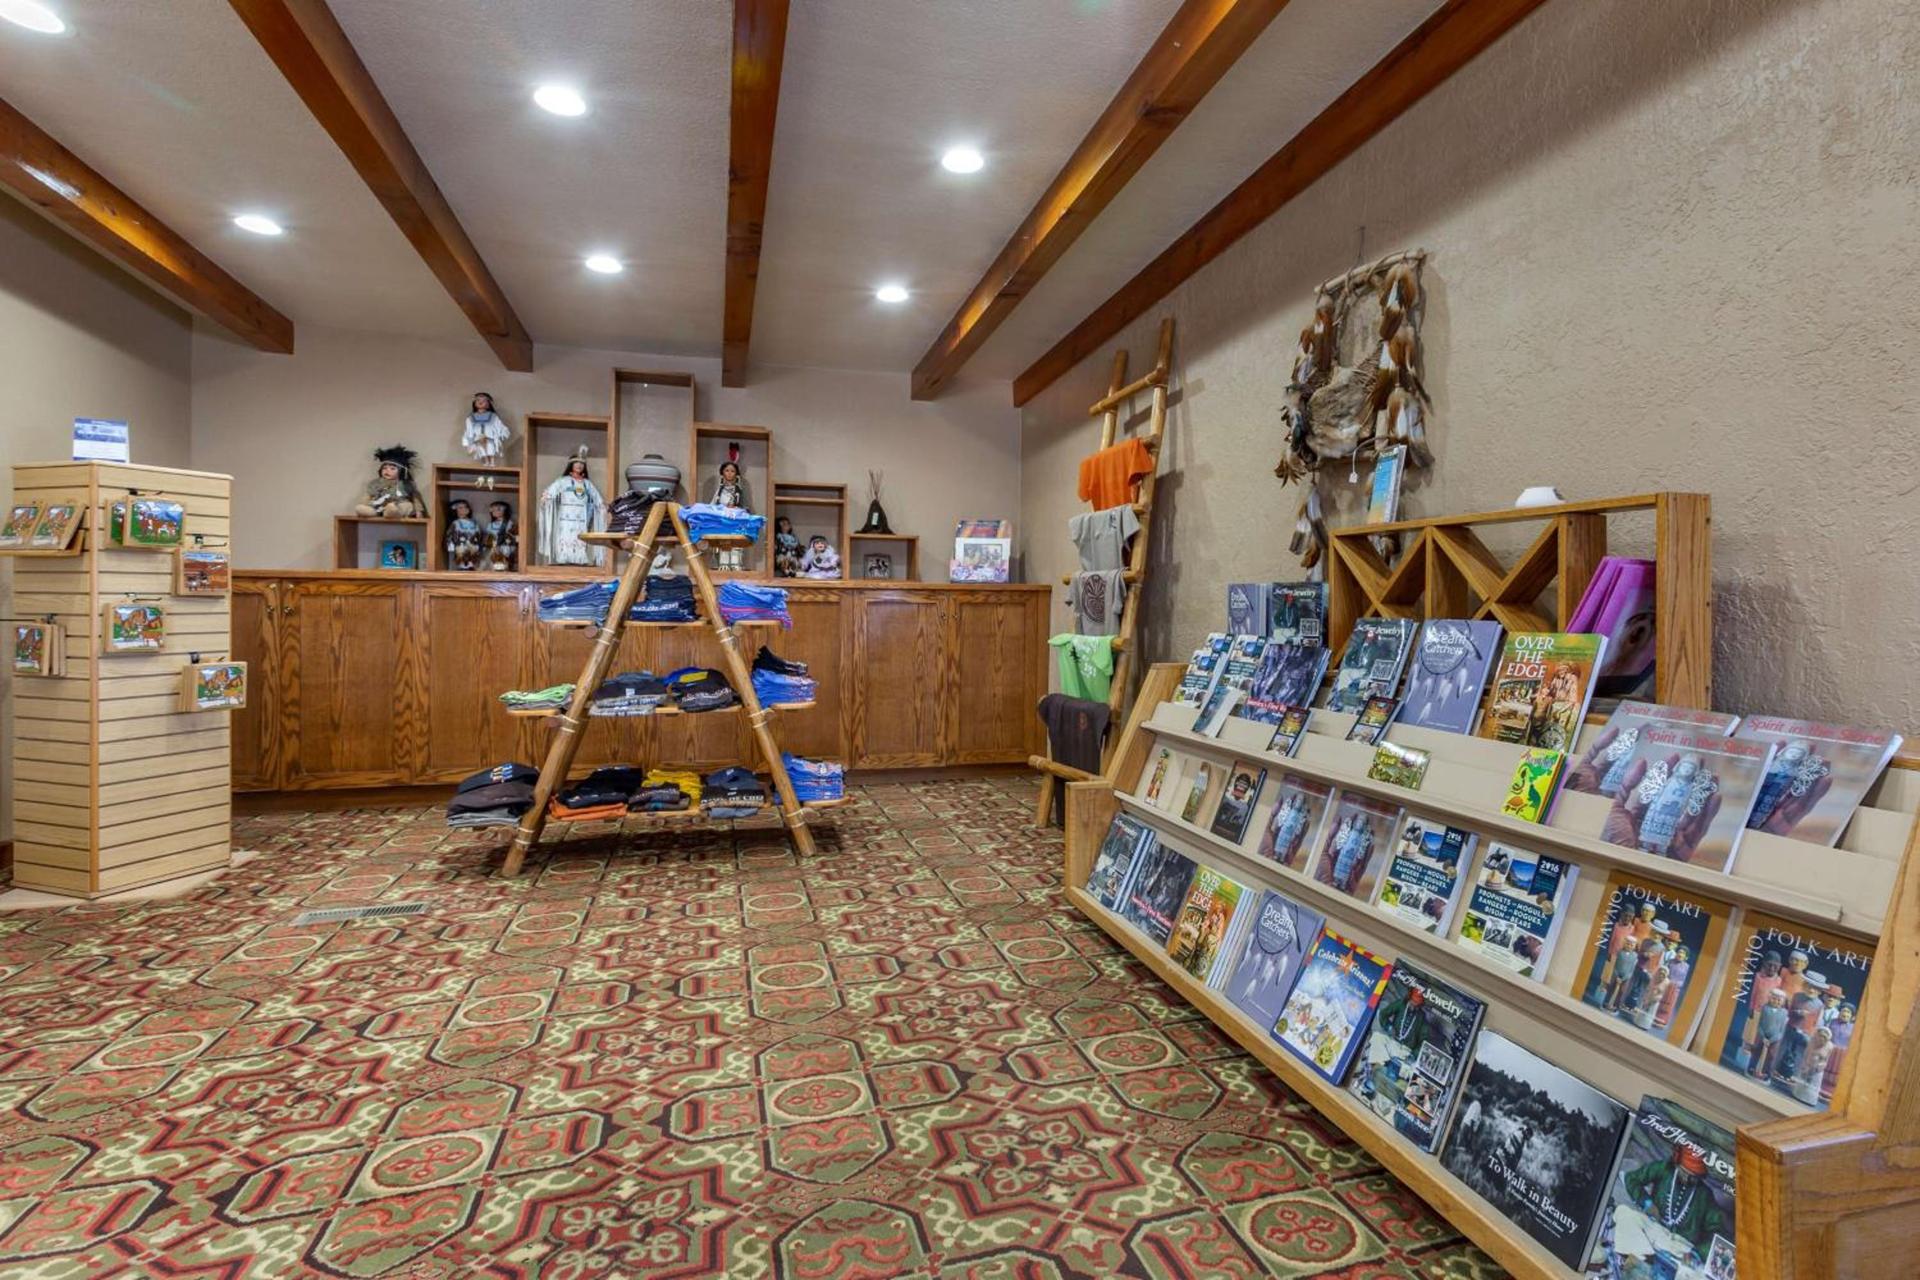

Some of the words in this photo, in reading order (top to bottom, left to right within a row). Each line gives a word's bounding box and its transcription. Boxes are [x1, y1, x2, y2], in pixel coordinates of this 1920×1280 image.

[1515, 635, 1555, 650] OVER
[1515, 649, 1545, 664] THE
[1506, 663, 1548, 678] EDGE
[1747, 717, 1784, 734] Spirit
[1645, 729, 1676, 746] Spirit
[1681, 734, 1692, 745] in
[1199, 881, 1215, 897] THE
[1200, 870, 1221, 889] OVER
[1191, 892, 1213, 911] EDGE
[1478, 888, 1511, 906] PROPHETS
[1478, 896, 1508, 912] RANGERS
[1624, 882, 1665, 910] FOLK
[1669, 899, 1706, 920] ART
[1264, 903, 1294, 930] Dream
[1484, 906, 1505, 918] BISON
[1510, 916, 1532, 929] BEARS
[1594, 890, 1623, 950] NAVAJO
[1261, 915, 1290, 940] Catchers
[1765, 926, 1817, 957] FOLK
[1825, 948, 1872, 973] ART
[1730, 934, 1764, 1004] NAVAJO
[1423, 988, 1464, 1019] Jewelry
[1641, 1114, 1671, 1139] Fred
[1667, 1127, 1706, 1158] Harvey
[1488, 1154, 1502, 1174] To
[1503, 1165, 1528, 1194] Walk
[1528, 1185, 1540, 1204] in
[1540, 1195, 1578, 1234] Beauty
